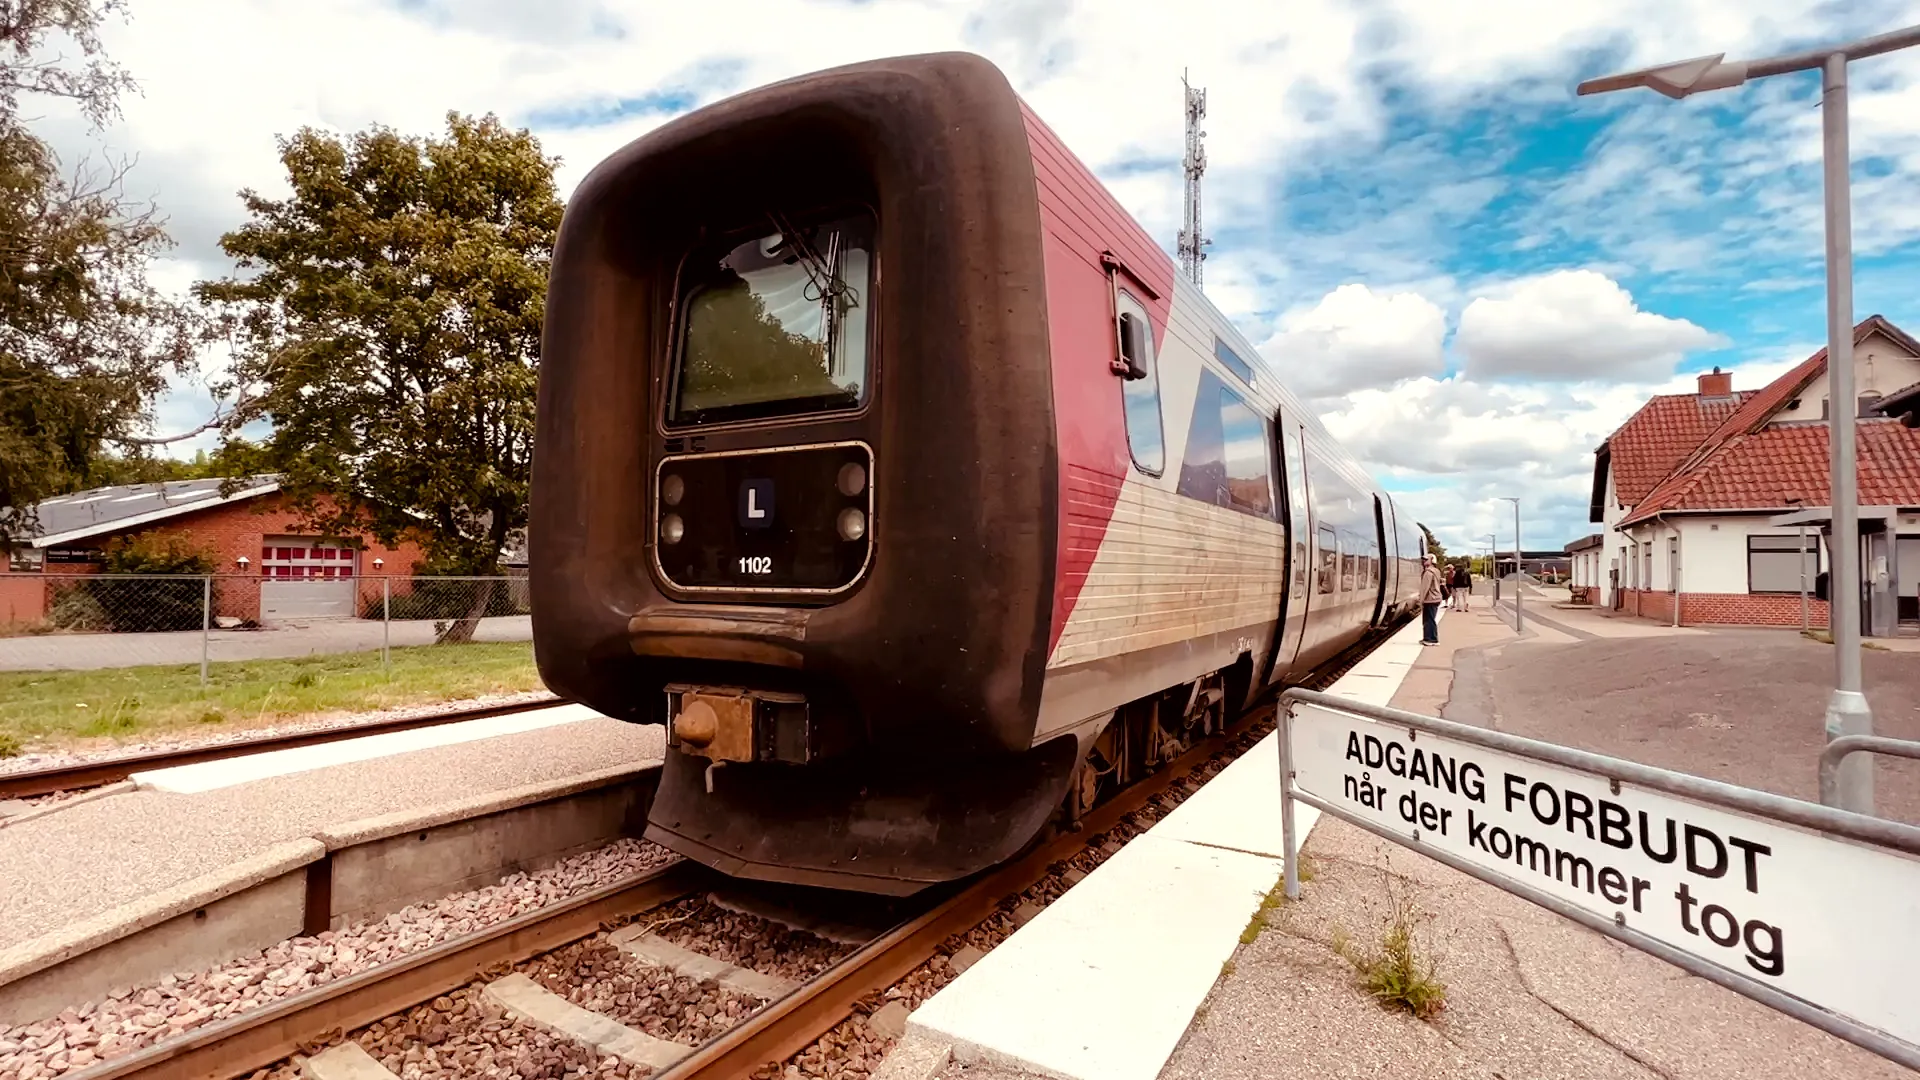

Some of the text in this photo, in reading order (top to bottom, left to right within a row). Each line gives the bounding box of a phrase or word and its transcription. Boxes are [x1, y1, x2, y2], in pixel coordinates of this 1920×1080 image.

[748, 488, 765, 519] L
[739, 556, 772, 574] 1102
[1346, 731, 1772, 894] ADGANG FORBUDT
[1344, 773, 1785, 977] når der kommer tog
